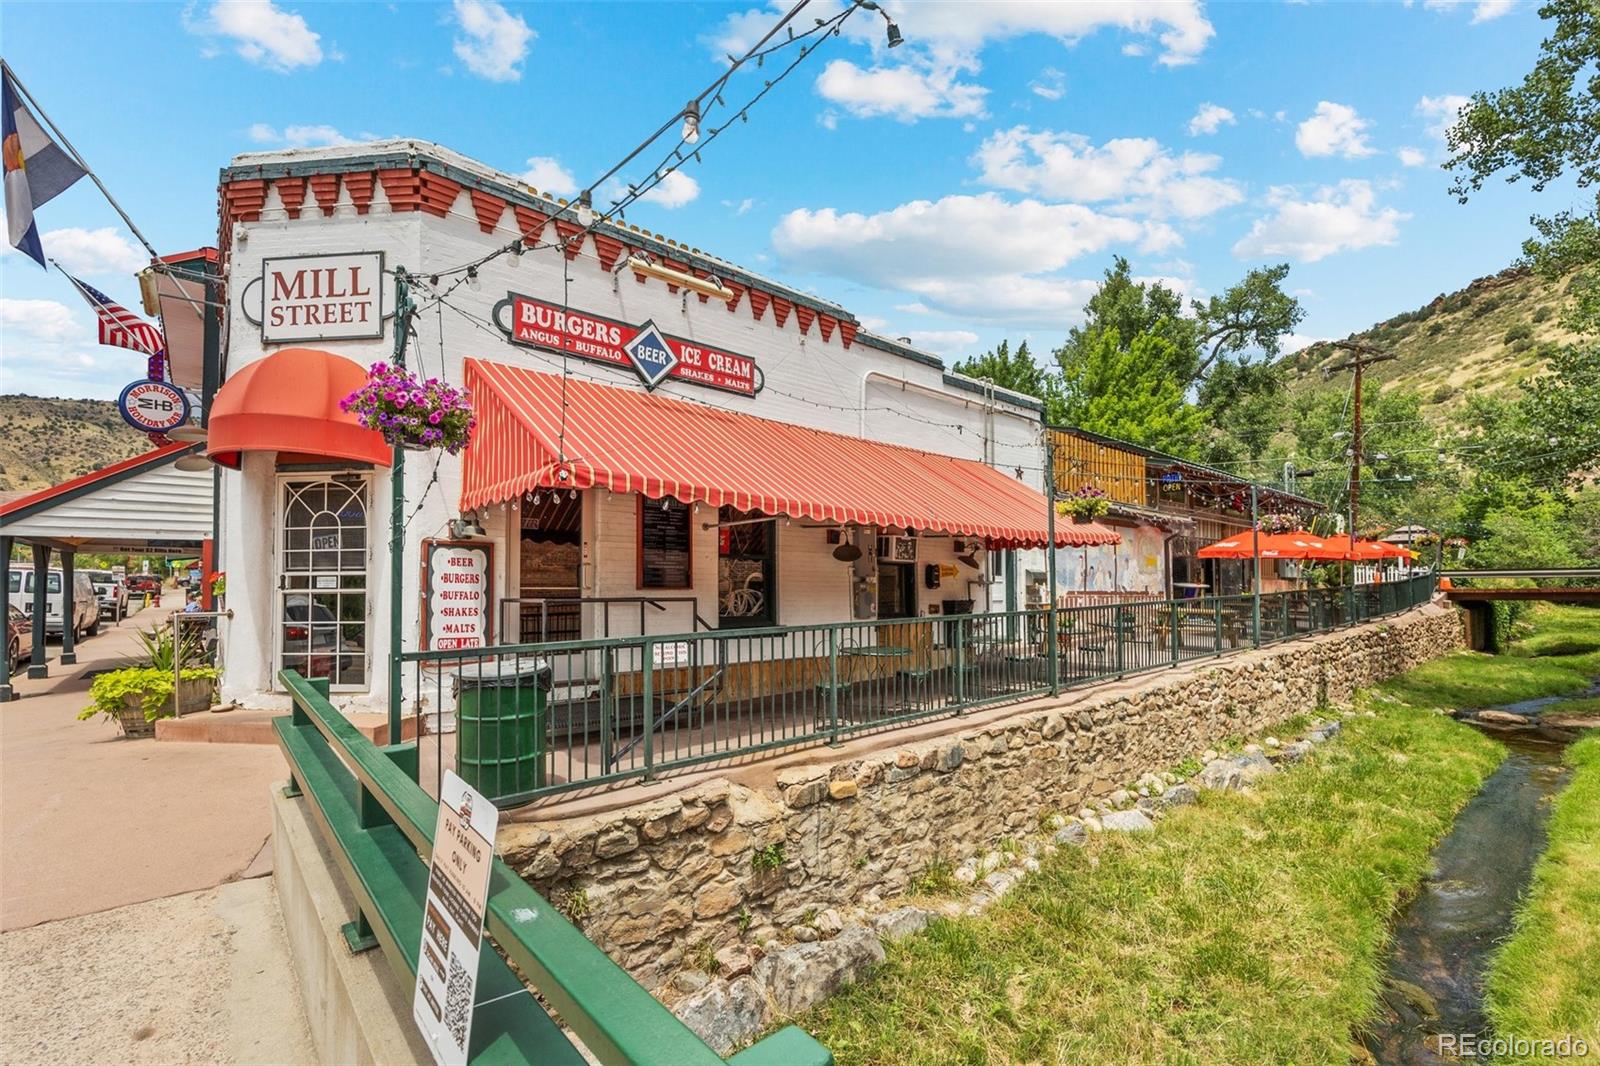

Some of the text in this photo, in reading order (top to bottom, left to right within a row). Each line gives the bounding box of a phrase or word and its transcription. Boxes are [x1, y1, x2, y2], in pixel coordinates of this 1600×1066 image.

[271, 266, 371, 301] MILL
[270, 301, 372, 327] STREET
[521, 302, 621, 345] BURGERS
[520, 328, 622, 361] ANGUS BUFFALO
[637, 344, 667, 366] BEER
[680, 345, 751, 378] ICE CREAM
[680, 367, 751, 390] SHAKES MALTS
[129, 385, 182, 405] MORRISON
[128, 406, 182, 427] HOLIDAY BAR
[1162, 483, 1181, 492] OPEN
[314, 535, 339, 550] OPEN
[450, 557, 474, 567] BEER
[443, 573, 480, 585] BURGERS
[442, 591, 480, 601] BUFFALO
[443, 607, 479, 617] SHAKES
[445, 623, 476, 633] MALTS
[438, 638, 480, 648] OPEN LATE
[445, 818, 457, 838] PAY
[456, 828, 482, 864] PARKING
[451, 850, 468, 876] ONLY
